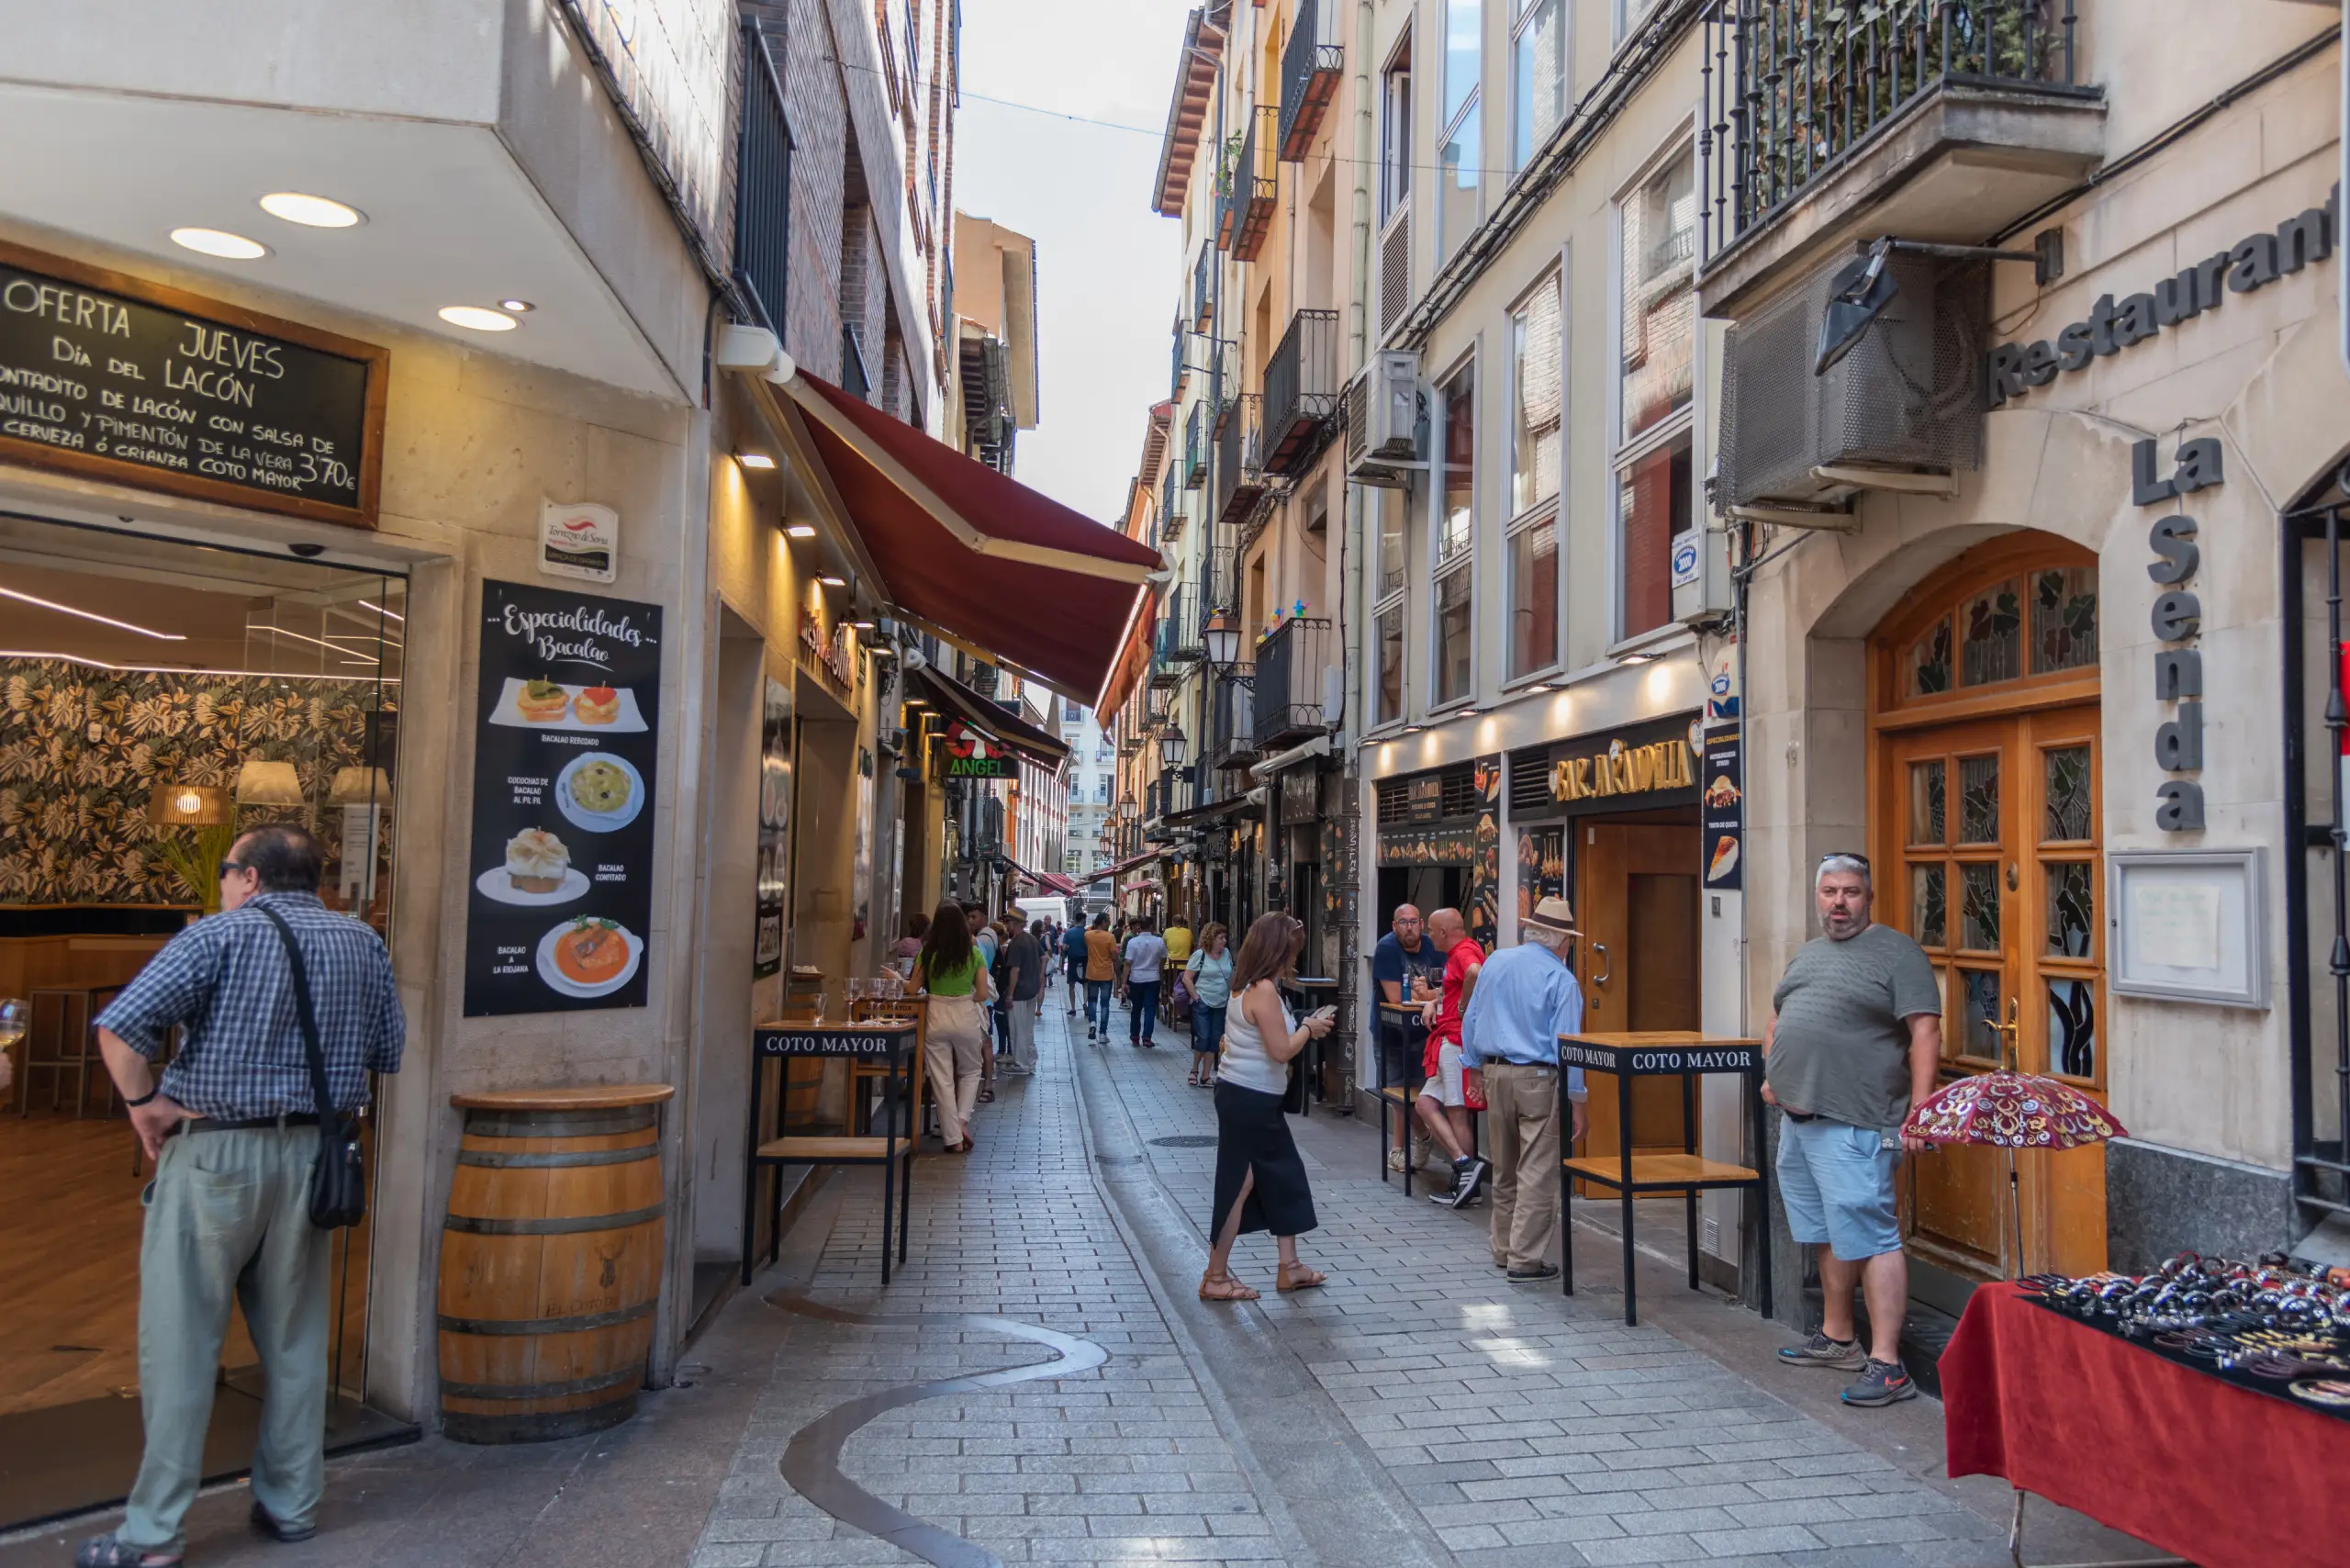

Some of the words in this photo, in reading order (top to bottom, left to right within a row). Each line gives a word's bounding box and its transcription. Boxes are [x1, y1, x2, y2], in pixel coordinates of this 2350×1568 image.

[4, 279, 130, 338] OFERTA
[179, 321, 285, 379] JUEVES
[106, 356, 146, 381] DEL
[164, 357, 256, 409] LACÓN
[101, 388, 126, 409] DE
[132, 397, 197, 425] LACÓN
[208, 415, 245, 435] CON
[252, 424, 305, 449] SALSA
[312, 436, 336, 455] DE
[81, 411, 93, 429] Y
[95, 414, 189, 451] PIMENTÓN
[197, 437, 225, 456] DE
[230, 445, 252, 461] LA
[254, 452, 293, 473] VERA
[3, 419, 85, 449] CERVEZA
[114, 443, 189, 472] CRIANZA
[198, 457, 247, 480] COTO
[252, 466, 303, 492] MAYOR
[2132, 435, 2225, 508] La
[1678, 554, 1693, 572] 2000
[504, 603, 643, 646] Especialidades
[537, 635, 610, 662] Bacalao
[1715, 680, 1727, 693] 2000
[542, 734, 568, 745] BACALAO
[570, 736, 599, 746] REBOZADO
[949, 758, 1007, 777] ANGEL
[508, 777, 540, 786] COCOCHAS
[1557, 758, 1590, 801] BAR
[513, 796, 521, 804] AL
[522, 796, 532, 804] PIL
[532, 797, 542, 805] PIL
[514, 787, 542, 796] BACALAO
[595, 873, 627, 881] CONFITADO
[599, 864, 624, 872] BACALAO
[498, 946, 527, 955] BACALAO
[493, 966, 501, 974] LA
[502, 965, 529, 974] RIOJANA
[766, 1036, 815, 1052] COTO
[822, 1037, 888, 1052] MAYOR
[1561, 1045, 1583, 1062] COTO
[1585, 1050, 1616, 1069] MAYOR
[1632, 1054, 1681, 1070] COTO
[1686, 1051, 1751, 1068] MAYOR
